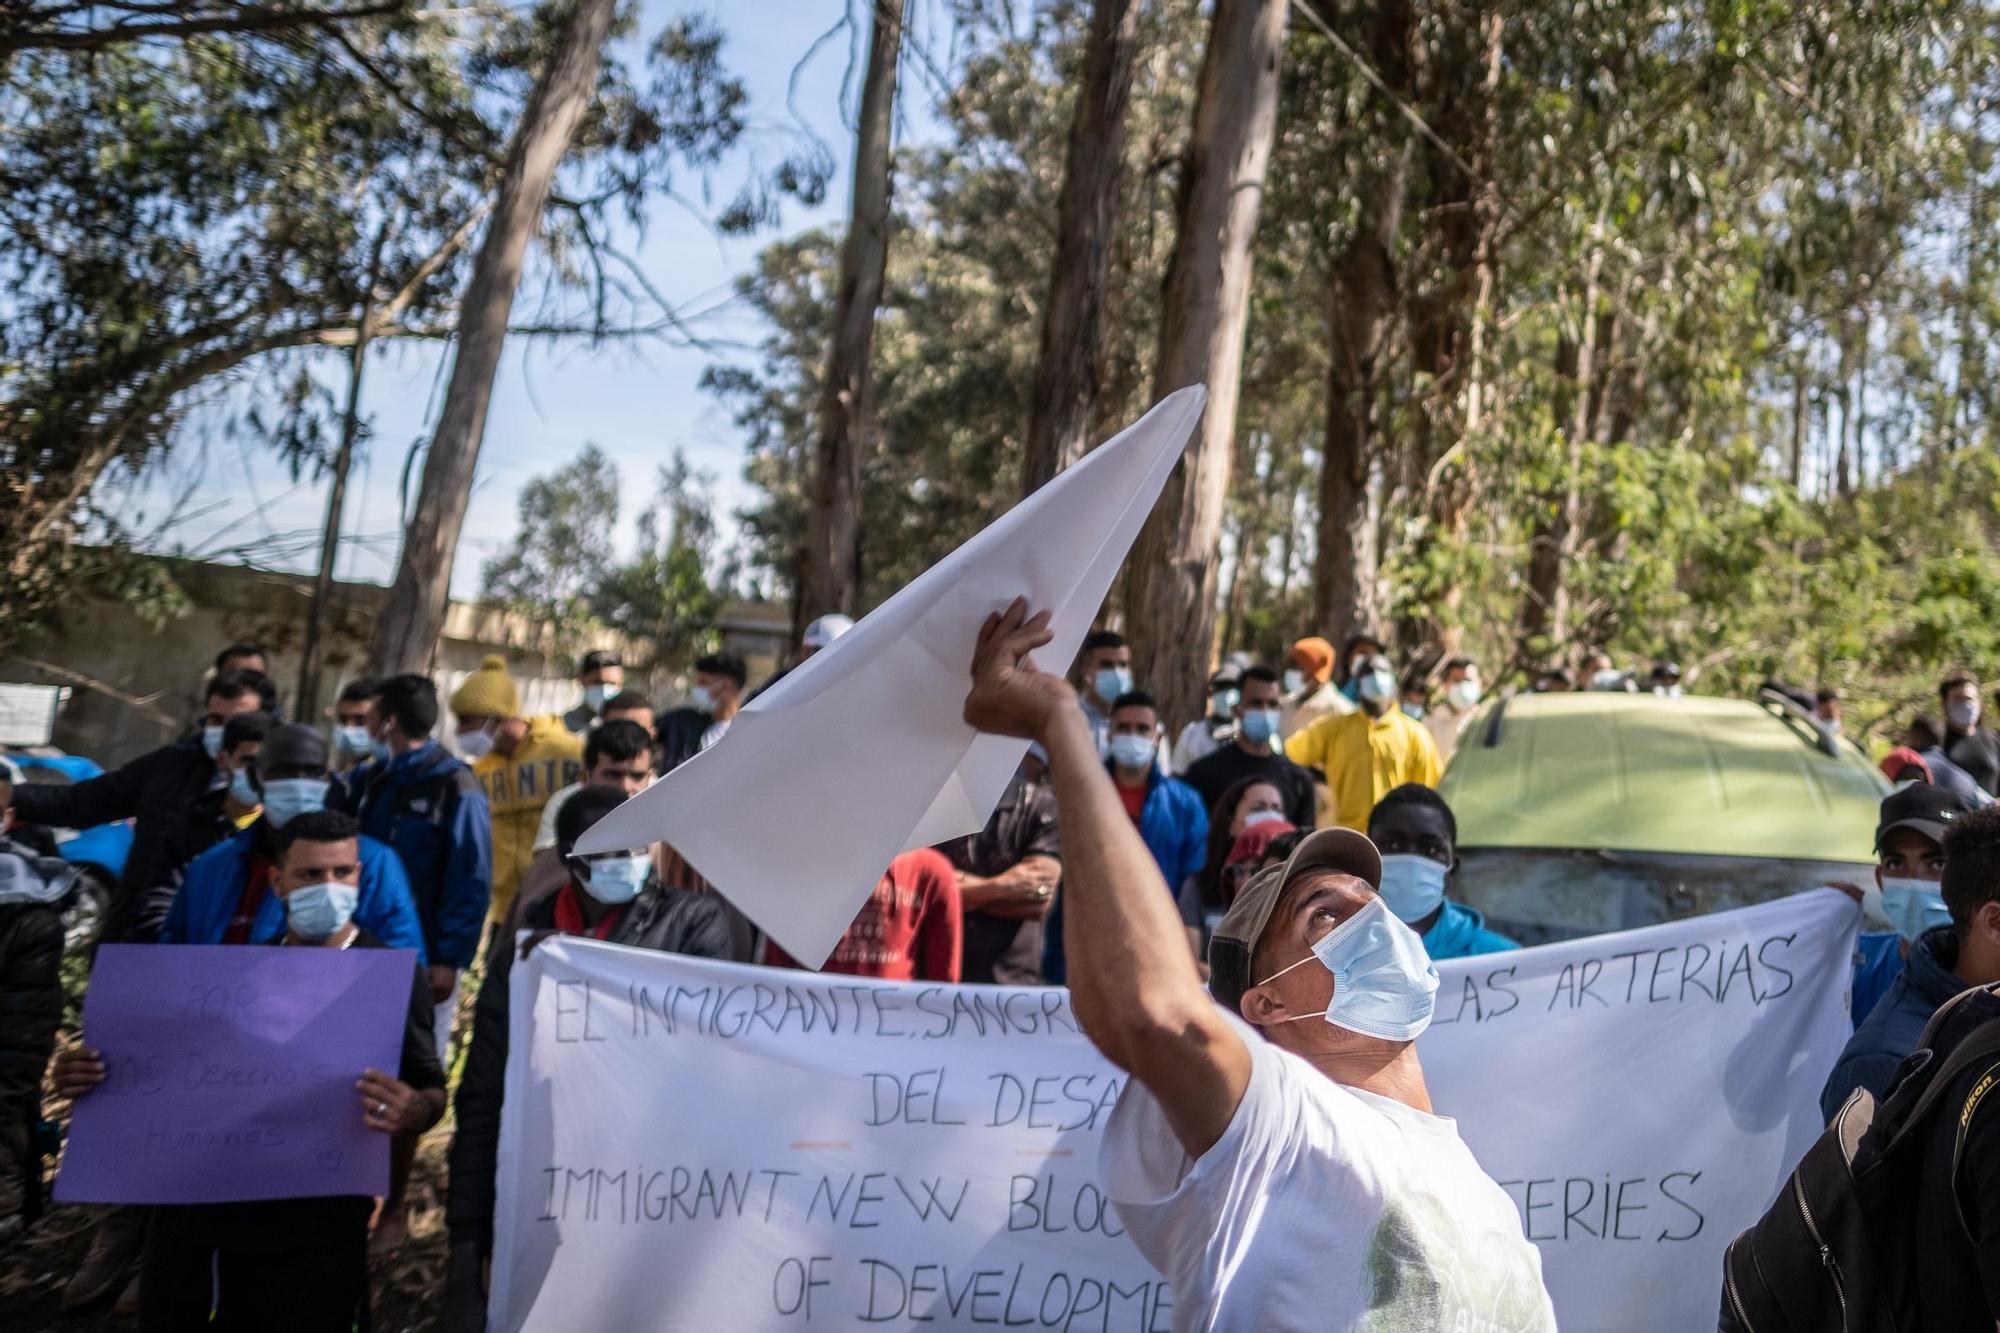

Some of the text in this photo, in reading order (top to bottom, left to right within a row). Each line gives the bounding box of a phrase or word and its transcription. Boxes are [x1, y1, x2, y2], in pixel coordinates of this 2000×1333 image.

[556, 980, 605, 1043] EL
[862, 1067, 966, 1127] DEL
[1961, 1076, 1992, 1127] Nikon
[806, 1172, 969, 1229] NEW
[773, 1257, 832, 1321] OF
